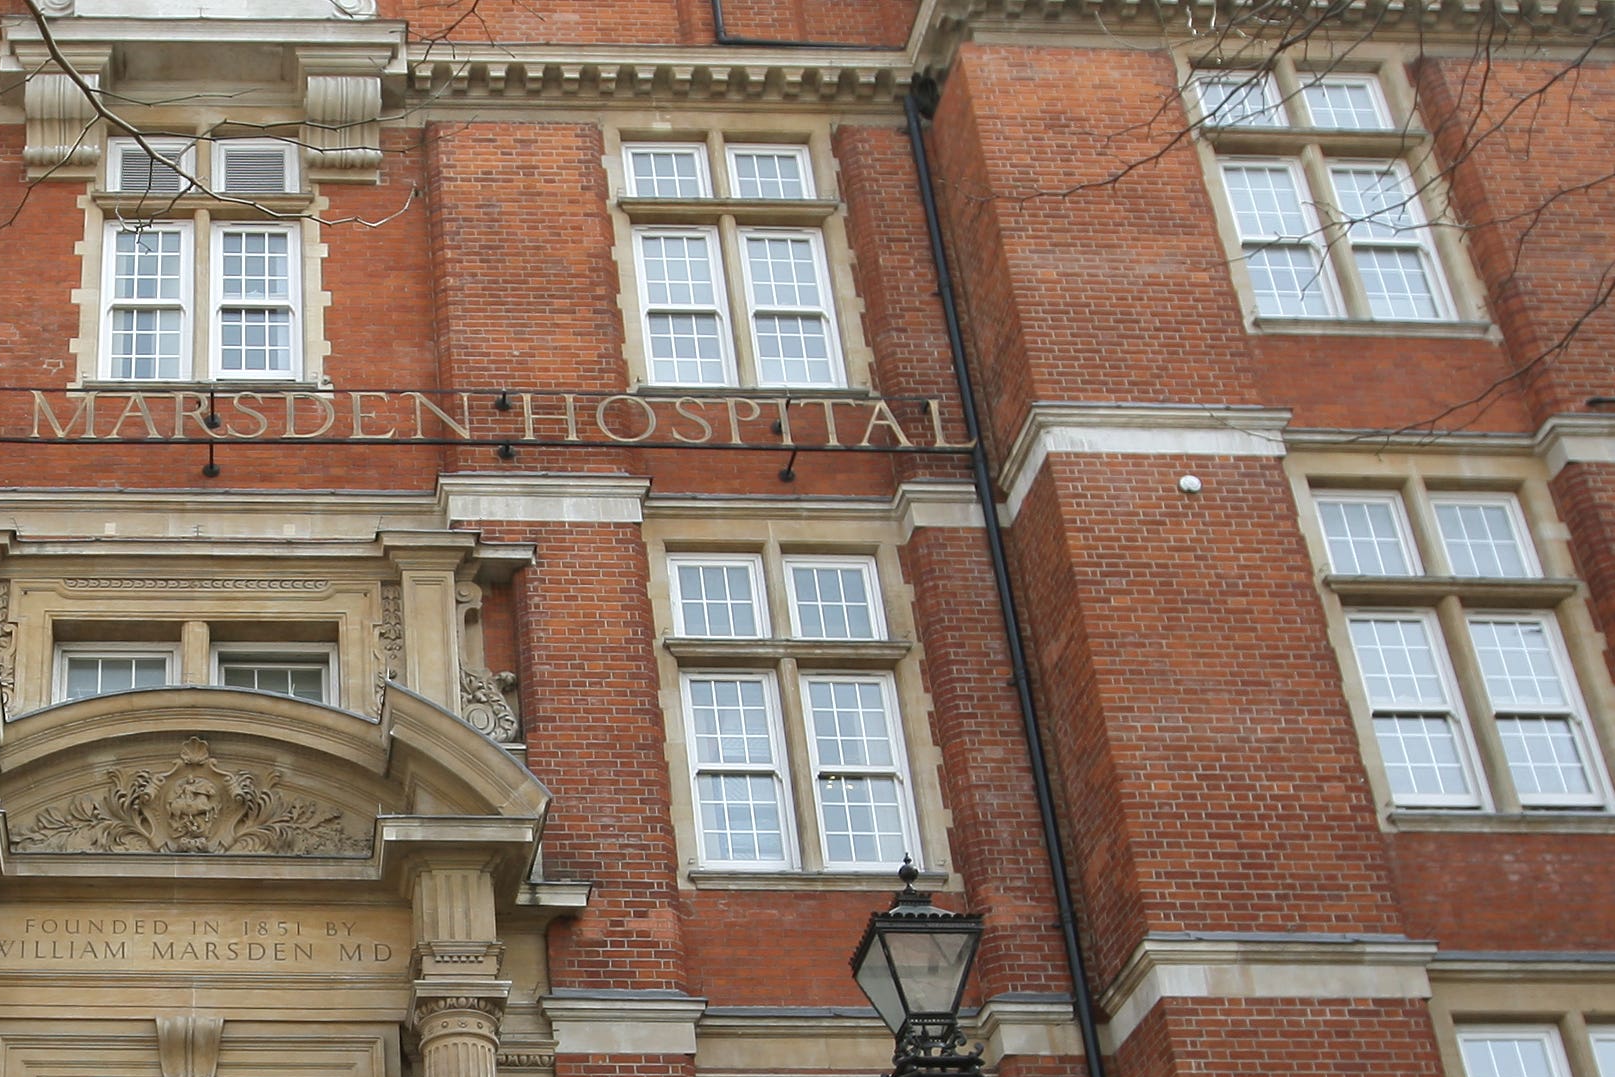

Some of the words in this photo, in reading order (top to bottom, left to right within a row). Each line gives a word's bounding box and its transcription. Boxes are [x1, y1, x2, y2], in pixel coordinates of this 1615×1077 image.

[28, 390, 473, 440] MARSDEN
[521, 392, 977, 447] HOSPITAL
[25, 918, 169, 936] FOUNDED
[192, 919, 222, 936] IN
[243, 920, 303, 936] 1851
[326, 920, 358, 937] BY
[151, 942, 315, 961] MARSDEN
